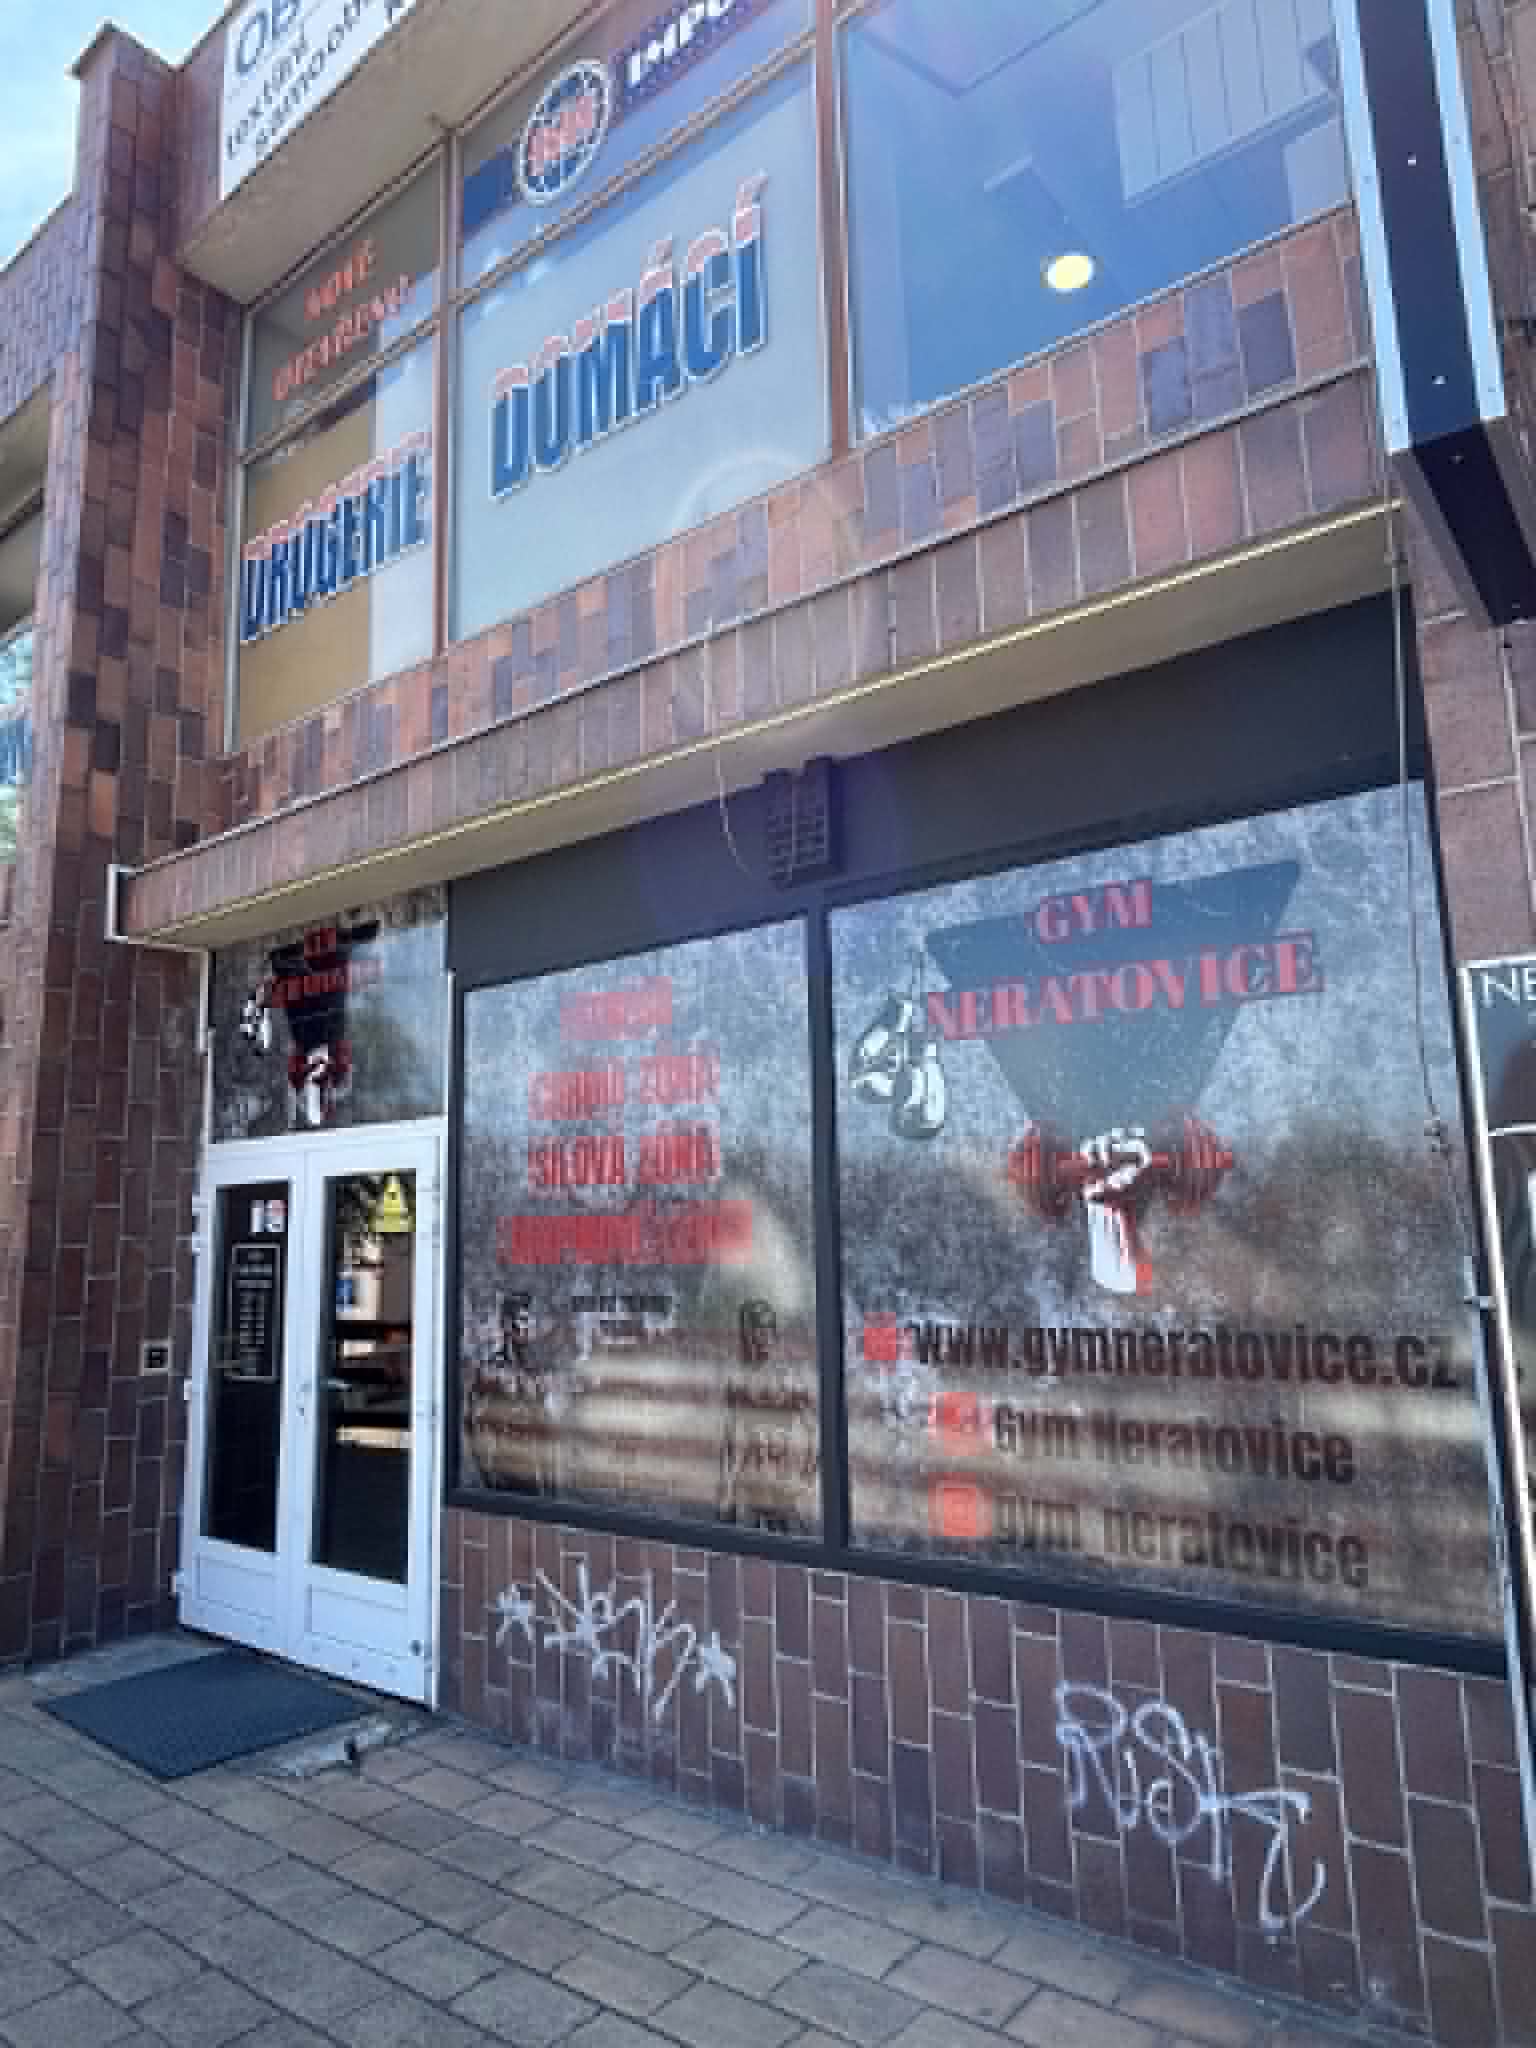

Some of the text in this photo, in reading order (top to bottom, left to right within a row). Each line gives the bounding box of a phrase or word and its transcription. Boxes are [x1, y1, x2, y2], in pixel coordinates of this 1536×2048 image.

[487, 170, 771, 501] DOMÁCÍ
[241, 429, 431, 648] DROGERIE
[1034, 879, 1152, 944] GYM
[926, 929, 1326, 1040] NERATOVICE
[908, 1320, 1460, 1388] www.gymneratovice.cz
[993, 1403, 1353, 1483] Gym Neratovice
